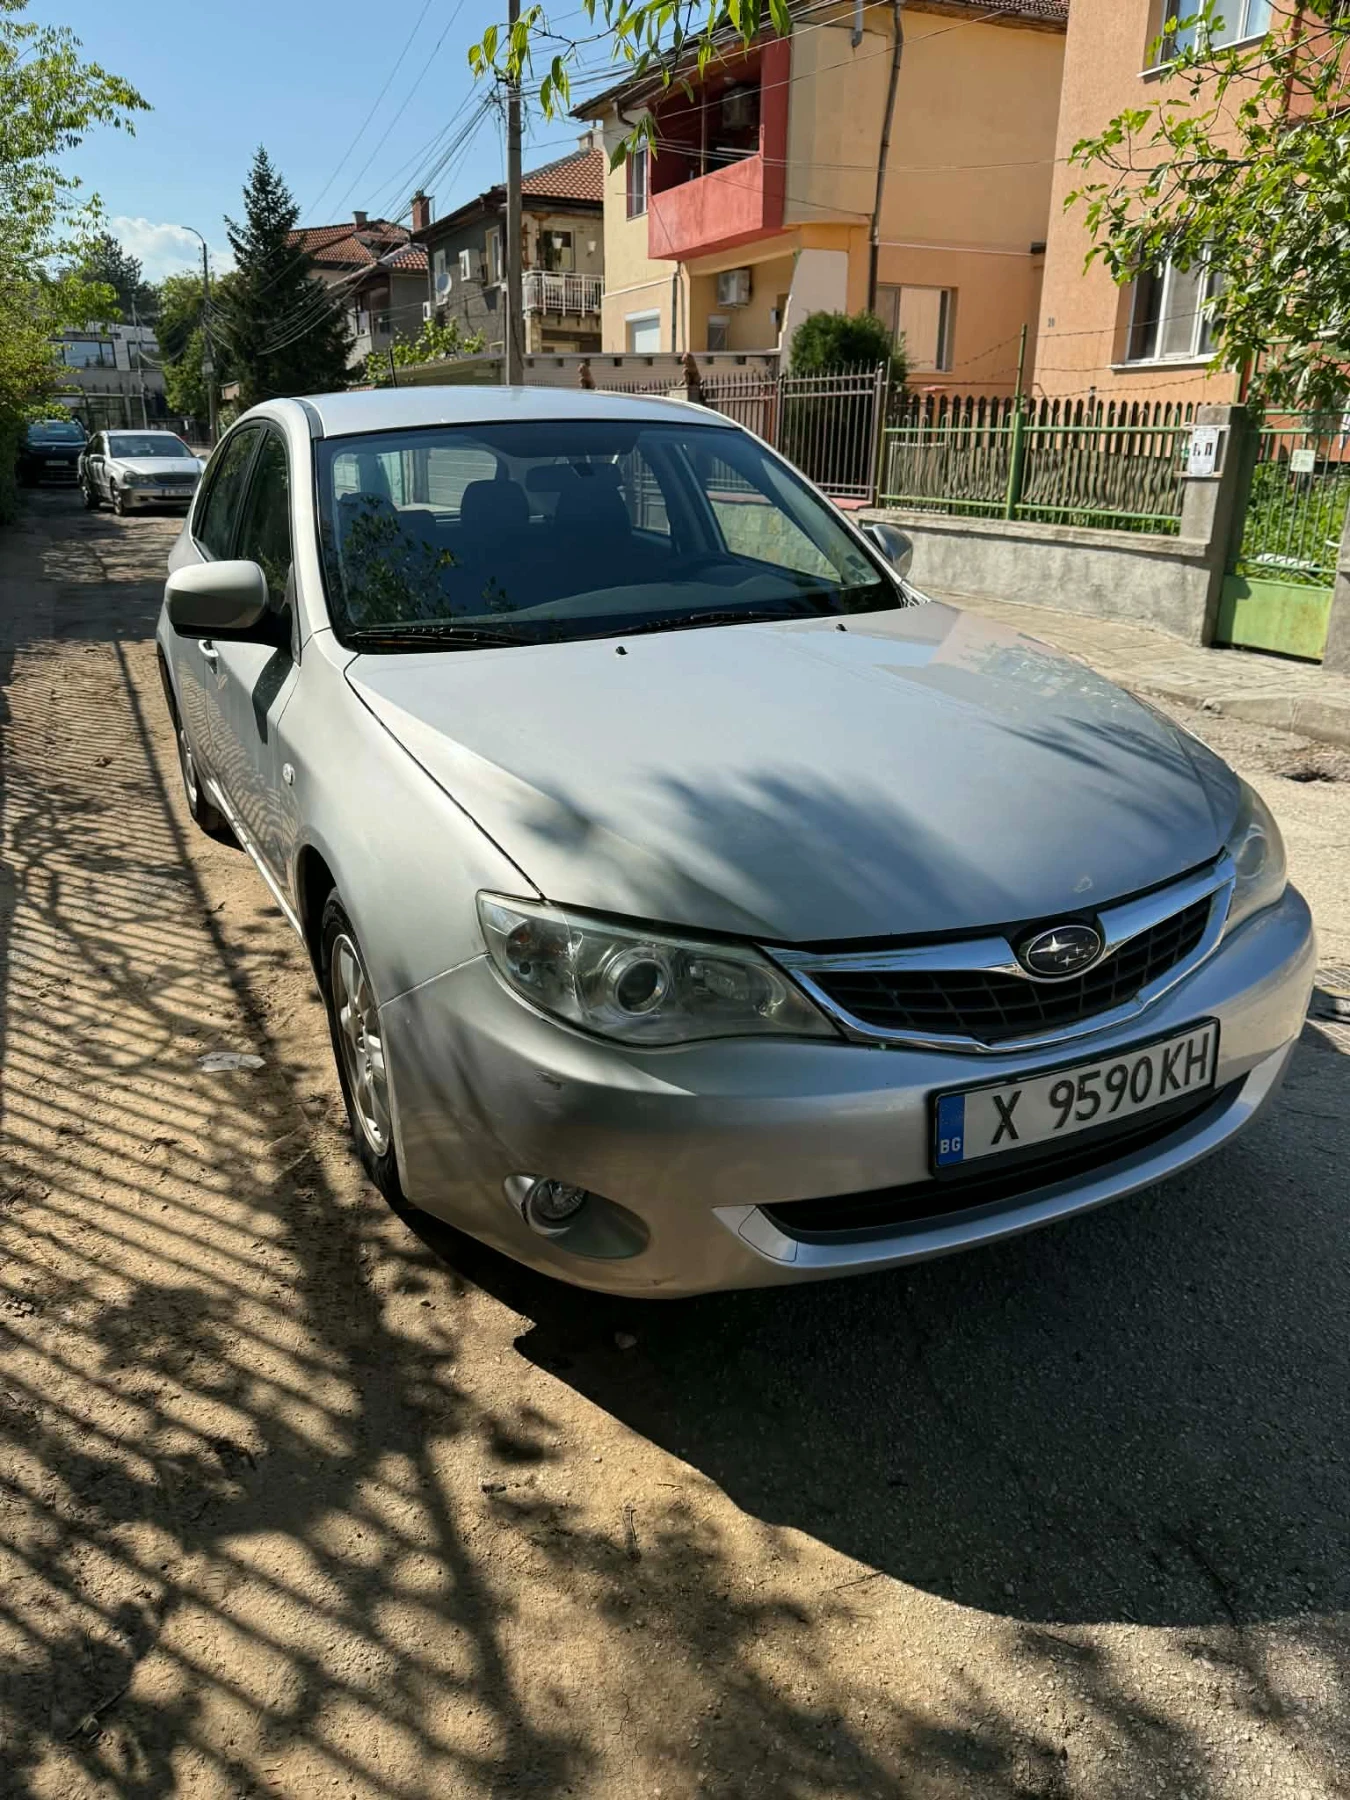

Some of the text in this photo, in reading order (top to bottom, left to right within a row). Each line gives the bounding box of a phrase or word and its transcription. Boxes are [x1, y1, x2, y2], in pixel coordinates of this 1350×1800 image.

[990, 1032, 1211, 1145] X 9590 KH
[940, 1136, 961, 1154] BG
